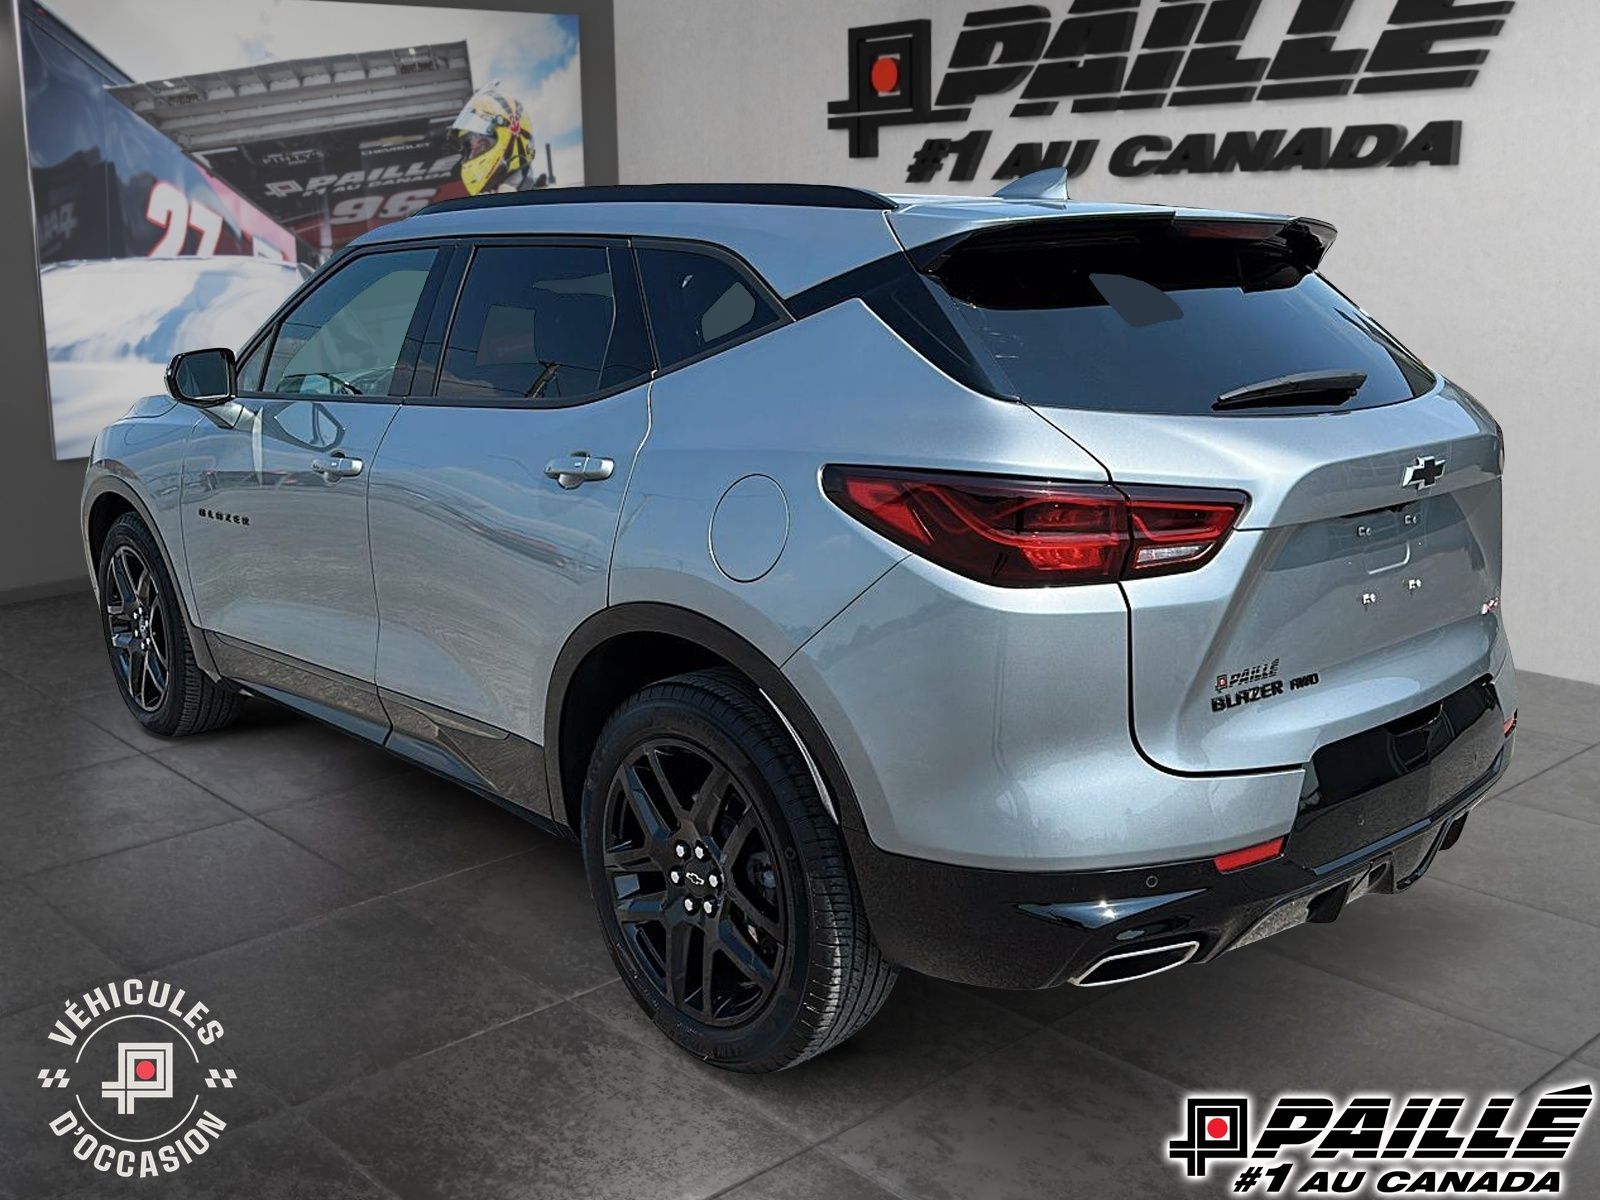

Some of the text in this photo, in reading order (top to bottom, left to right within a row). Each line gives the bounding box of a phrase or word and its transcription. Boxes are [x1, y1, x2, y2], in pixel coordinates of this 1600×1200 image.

[904, 120, 1463, 183] #1 AU CANADA
[331, 184, 362, 194] AU
[368, 171, 452, 188] CANADA
[330, 188, 438, 226] 96
[1210, 673, 1320, 712] BLAZER AWD
